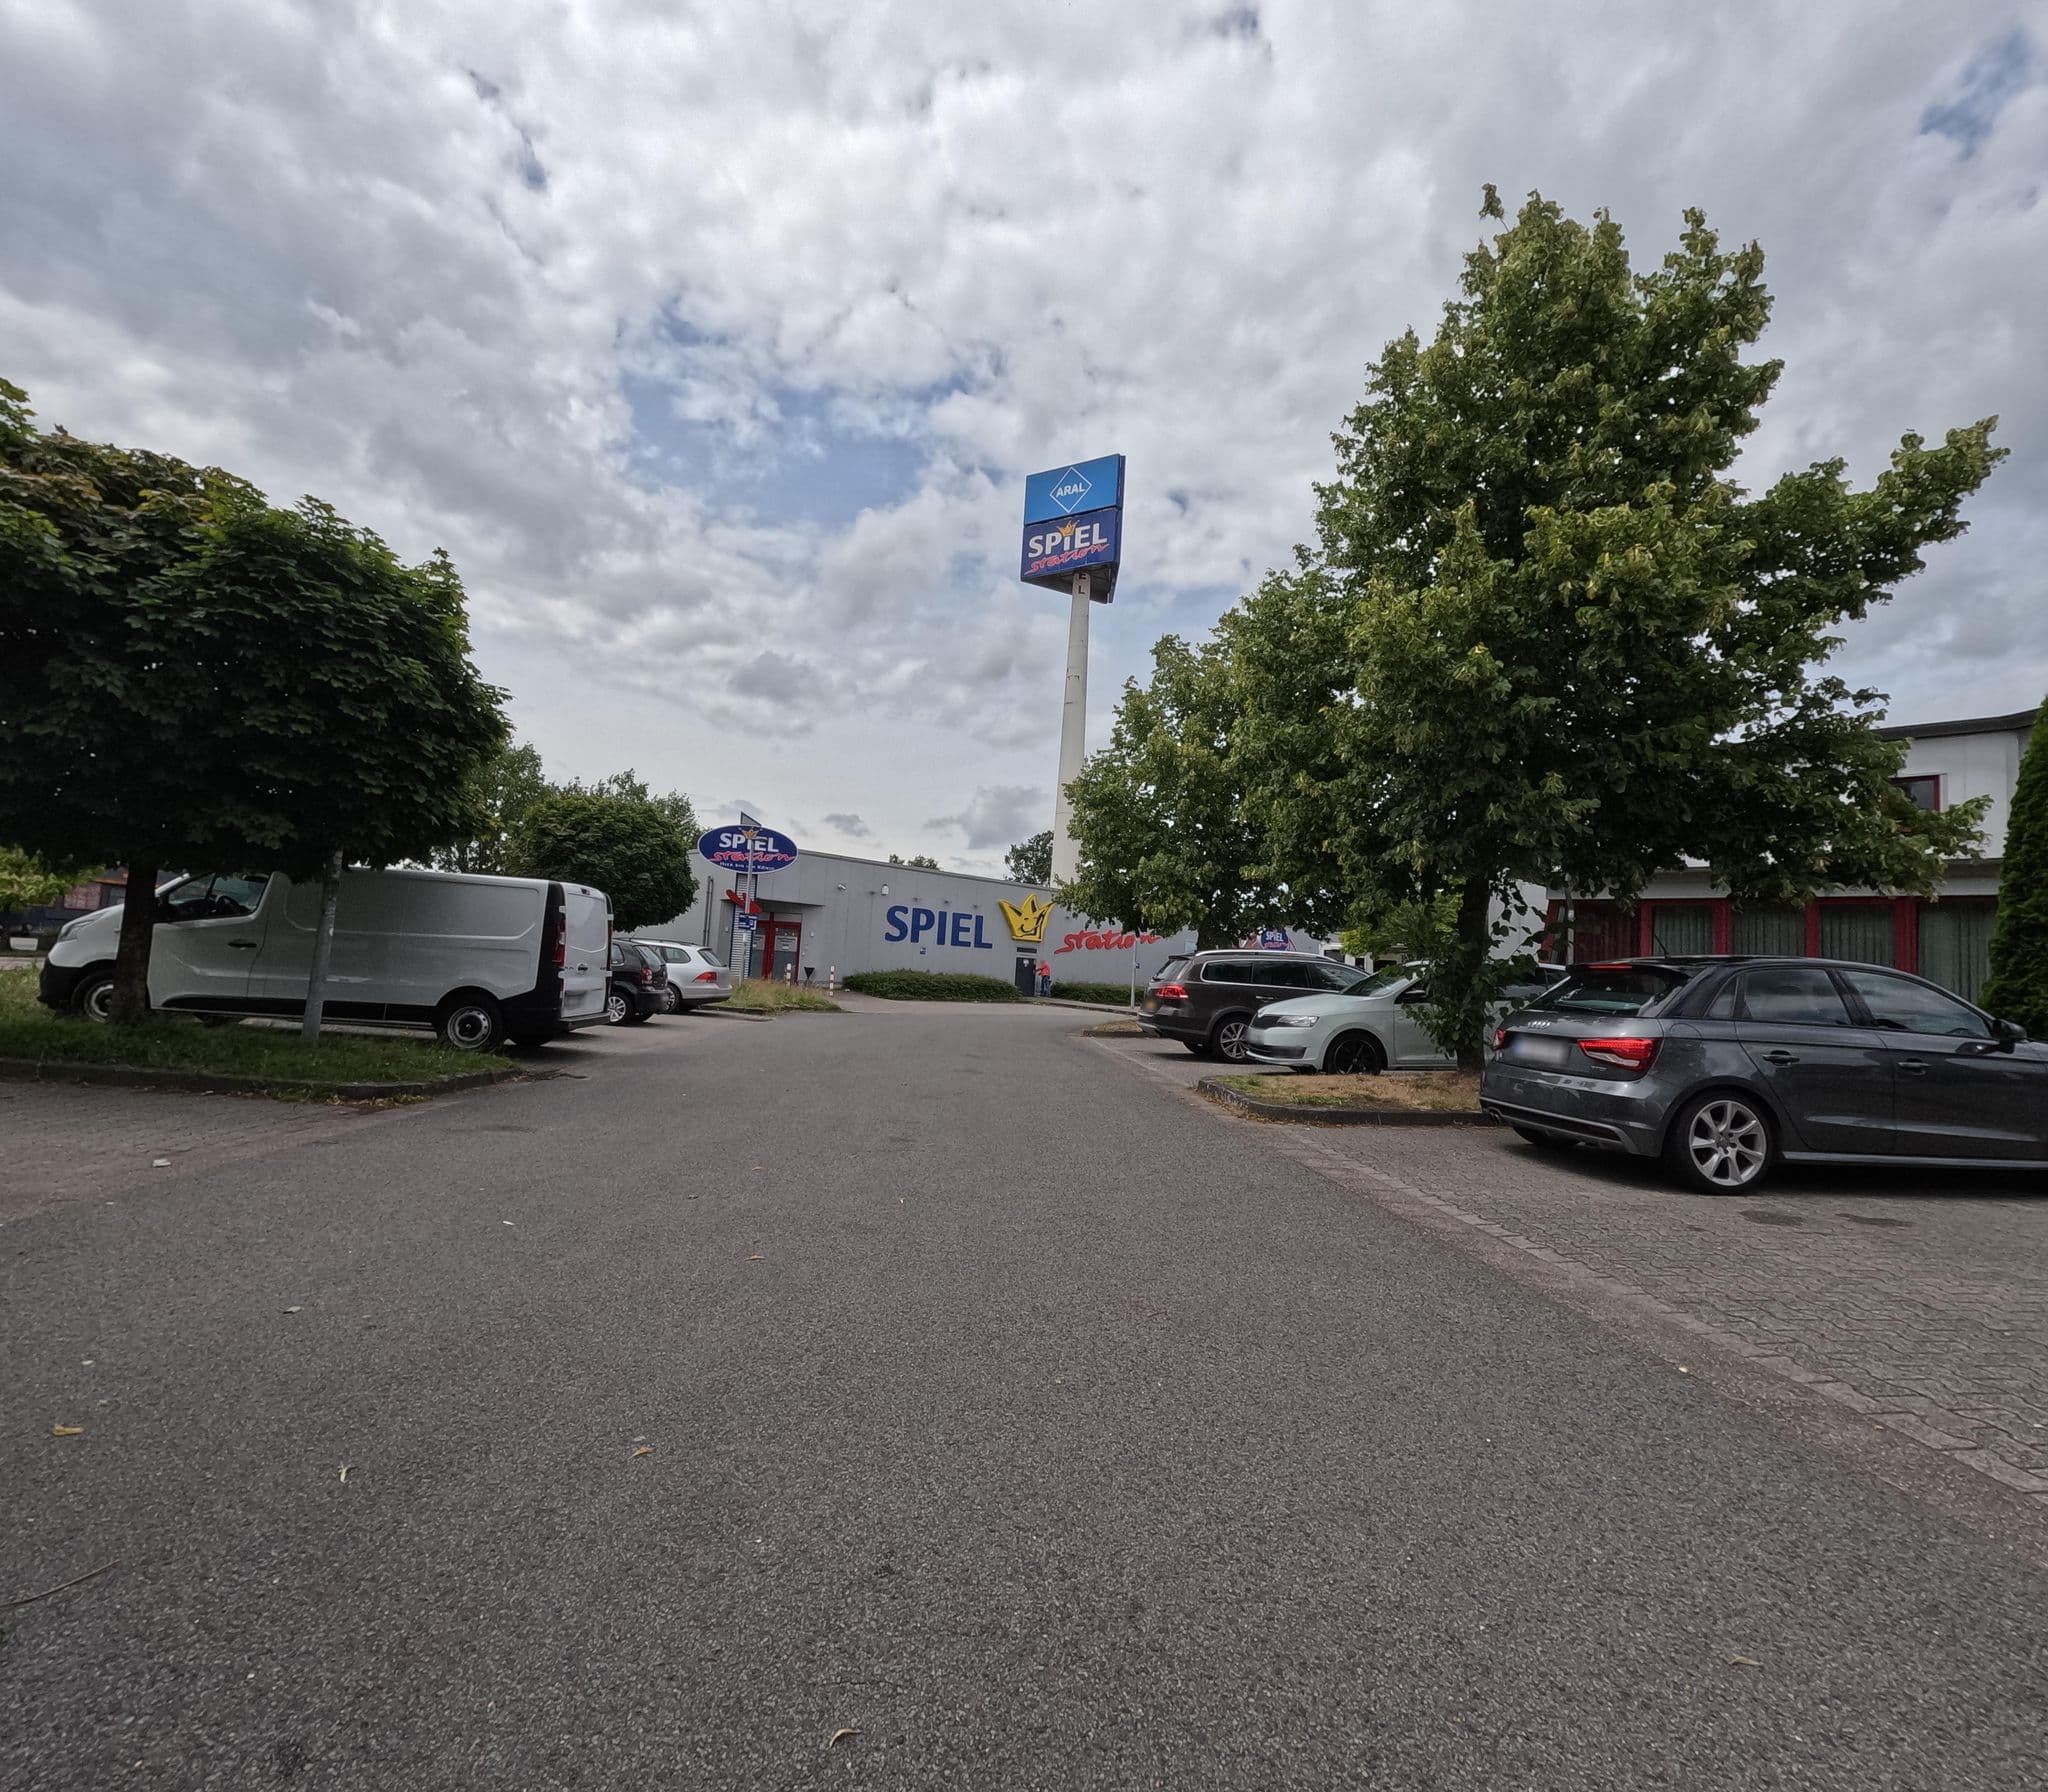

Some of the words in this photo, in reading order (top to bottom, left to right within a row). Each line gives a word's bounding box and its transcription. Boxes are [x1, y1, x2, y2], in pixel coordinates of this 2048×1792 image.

[1056, 482, 1085, 498] ARAL
[1028, 522, 1108, 558] SPIEL
[1024, 543, 1110, 576] station
[719, 833, 779, 853] SPIEL
[885, 905, 992, 949] SPIEL
[1054, 929, 1162, 954] station
